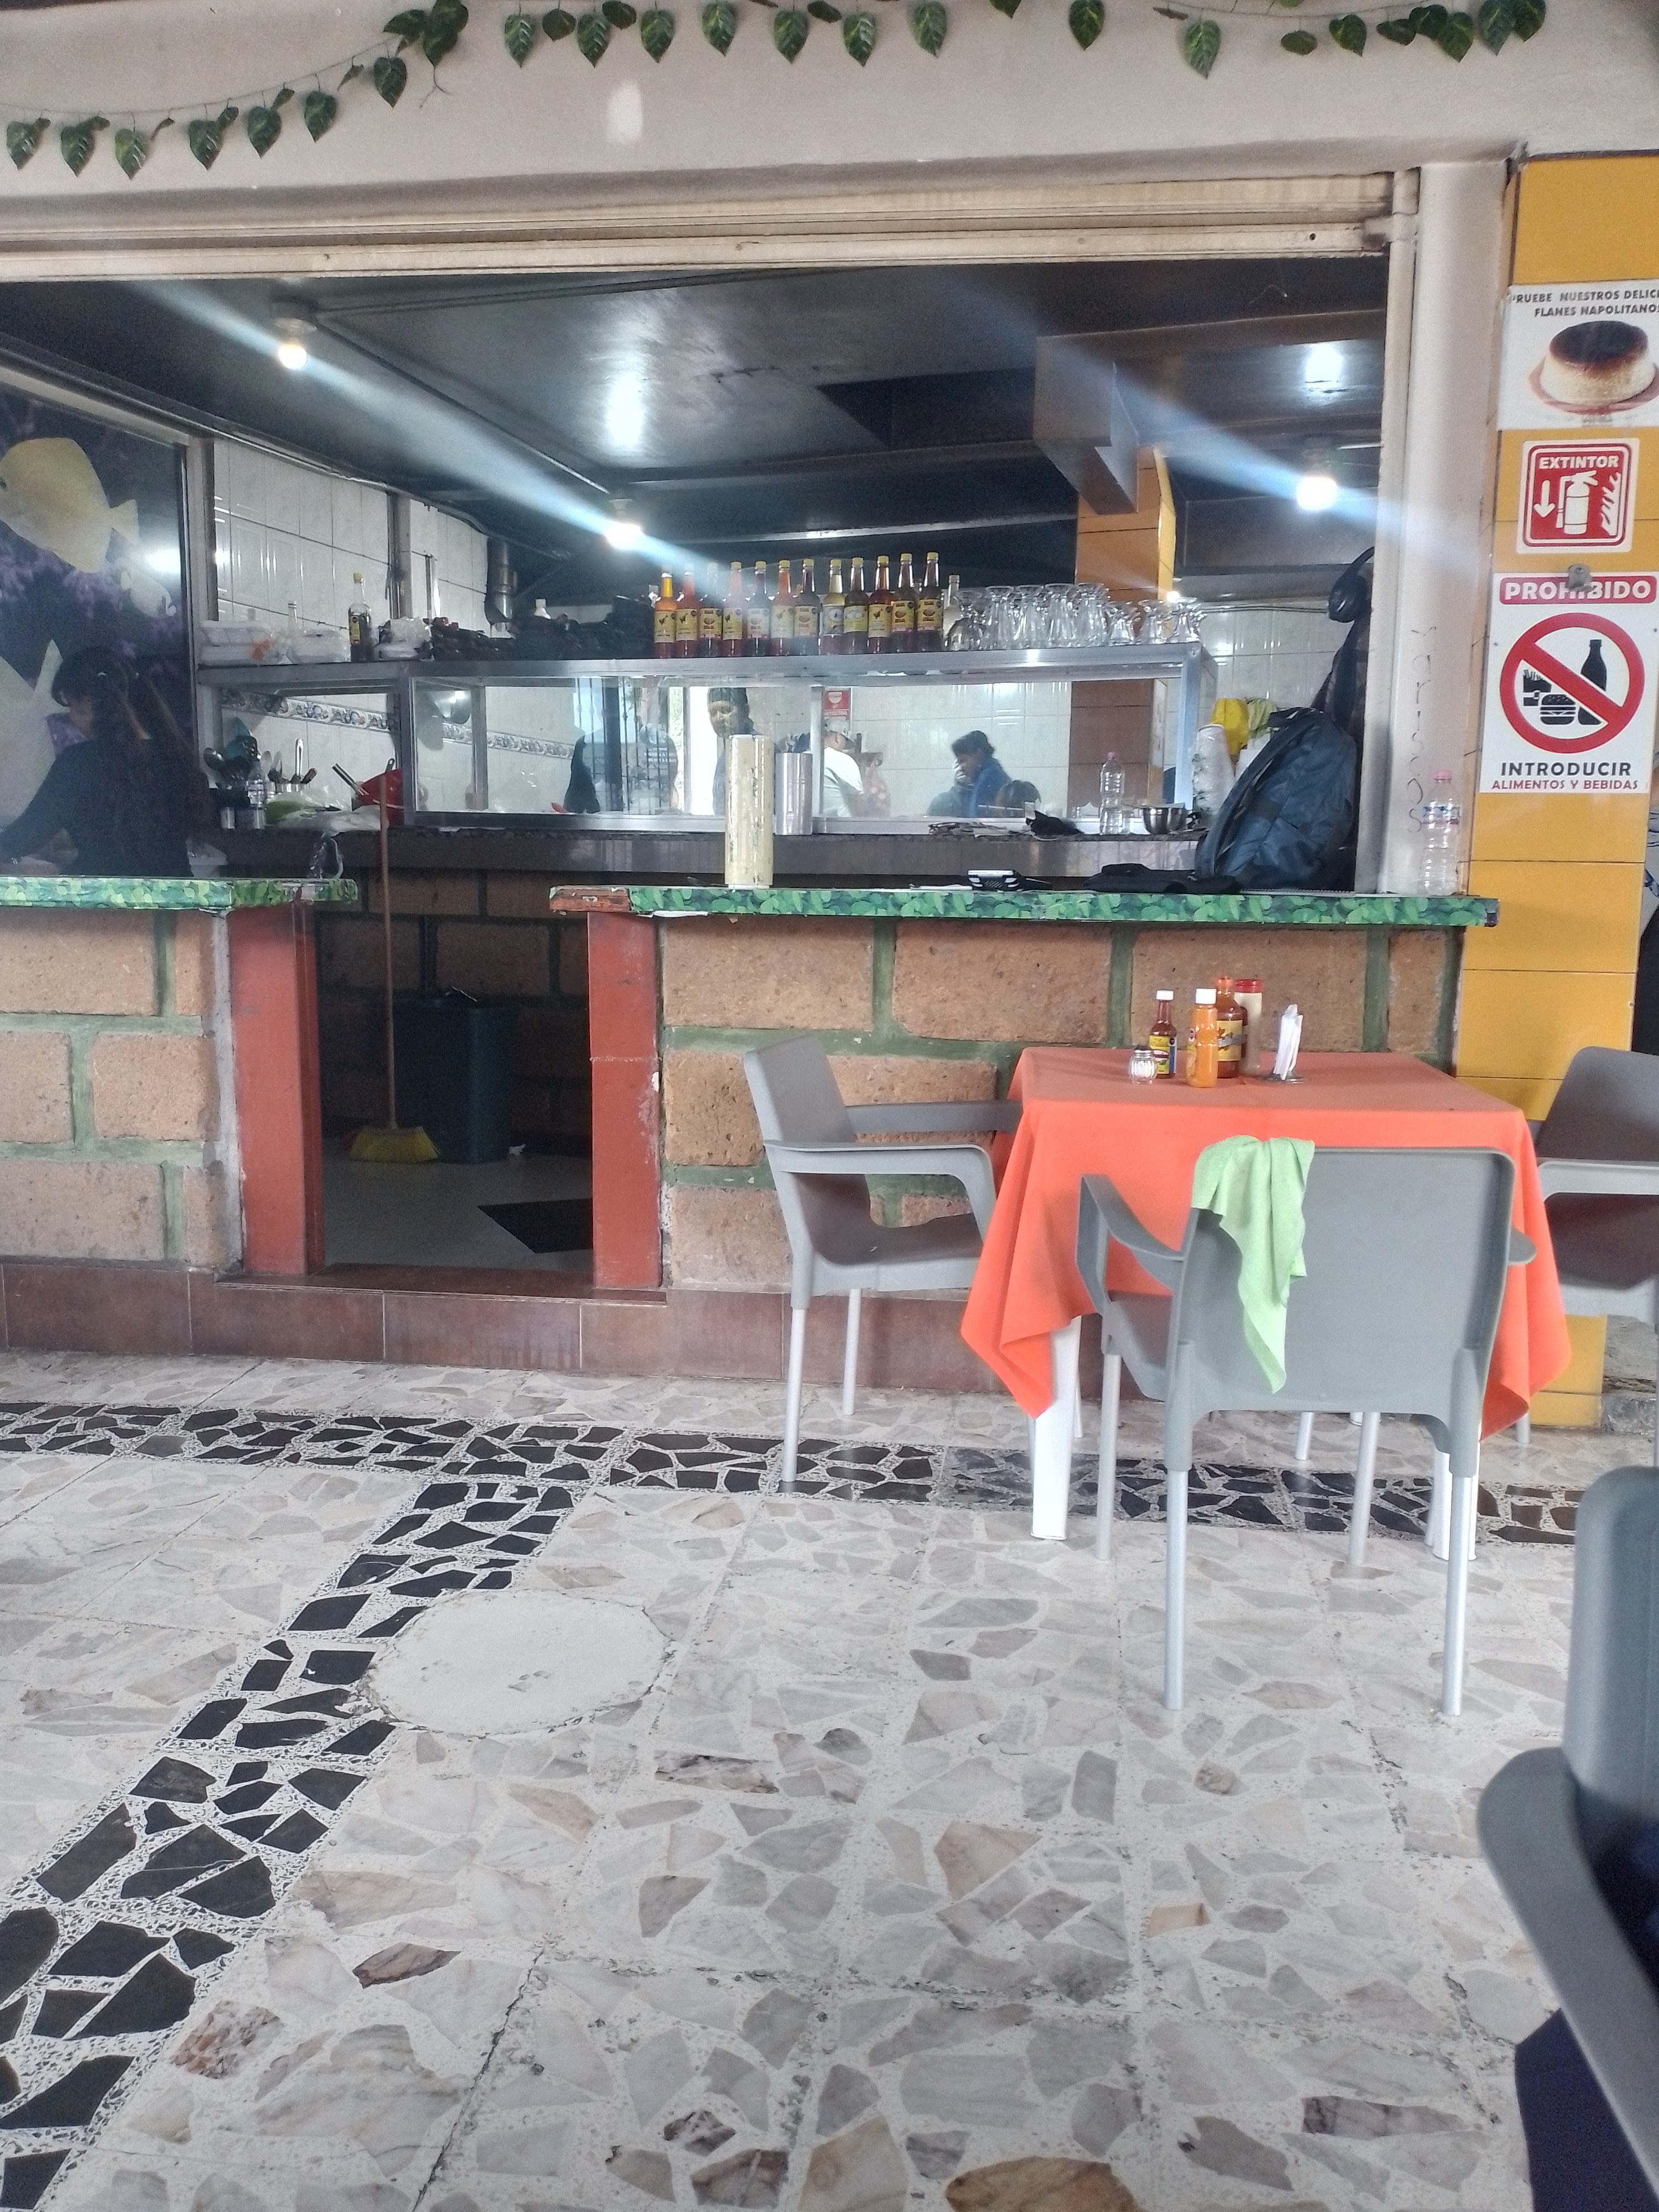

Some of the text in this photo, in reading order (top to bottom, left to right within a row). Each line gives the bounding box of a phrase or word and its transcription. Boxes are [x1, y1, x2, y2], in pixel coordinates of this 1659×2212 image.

[1512, 293, 1552, 303] RUEBE
[1559, 290, 1620, 301] NUESTROS
[1534, 306, 1577, 317] FLANES
[1539, 455, 1620, 469] EXTINTOR
[1501, 762, 1631, 776] INTRODUCIR
[1491, 780, 1637, 790] ALIMENTOS Y BEBIDAS
